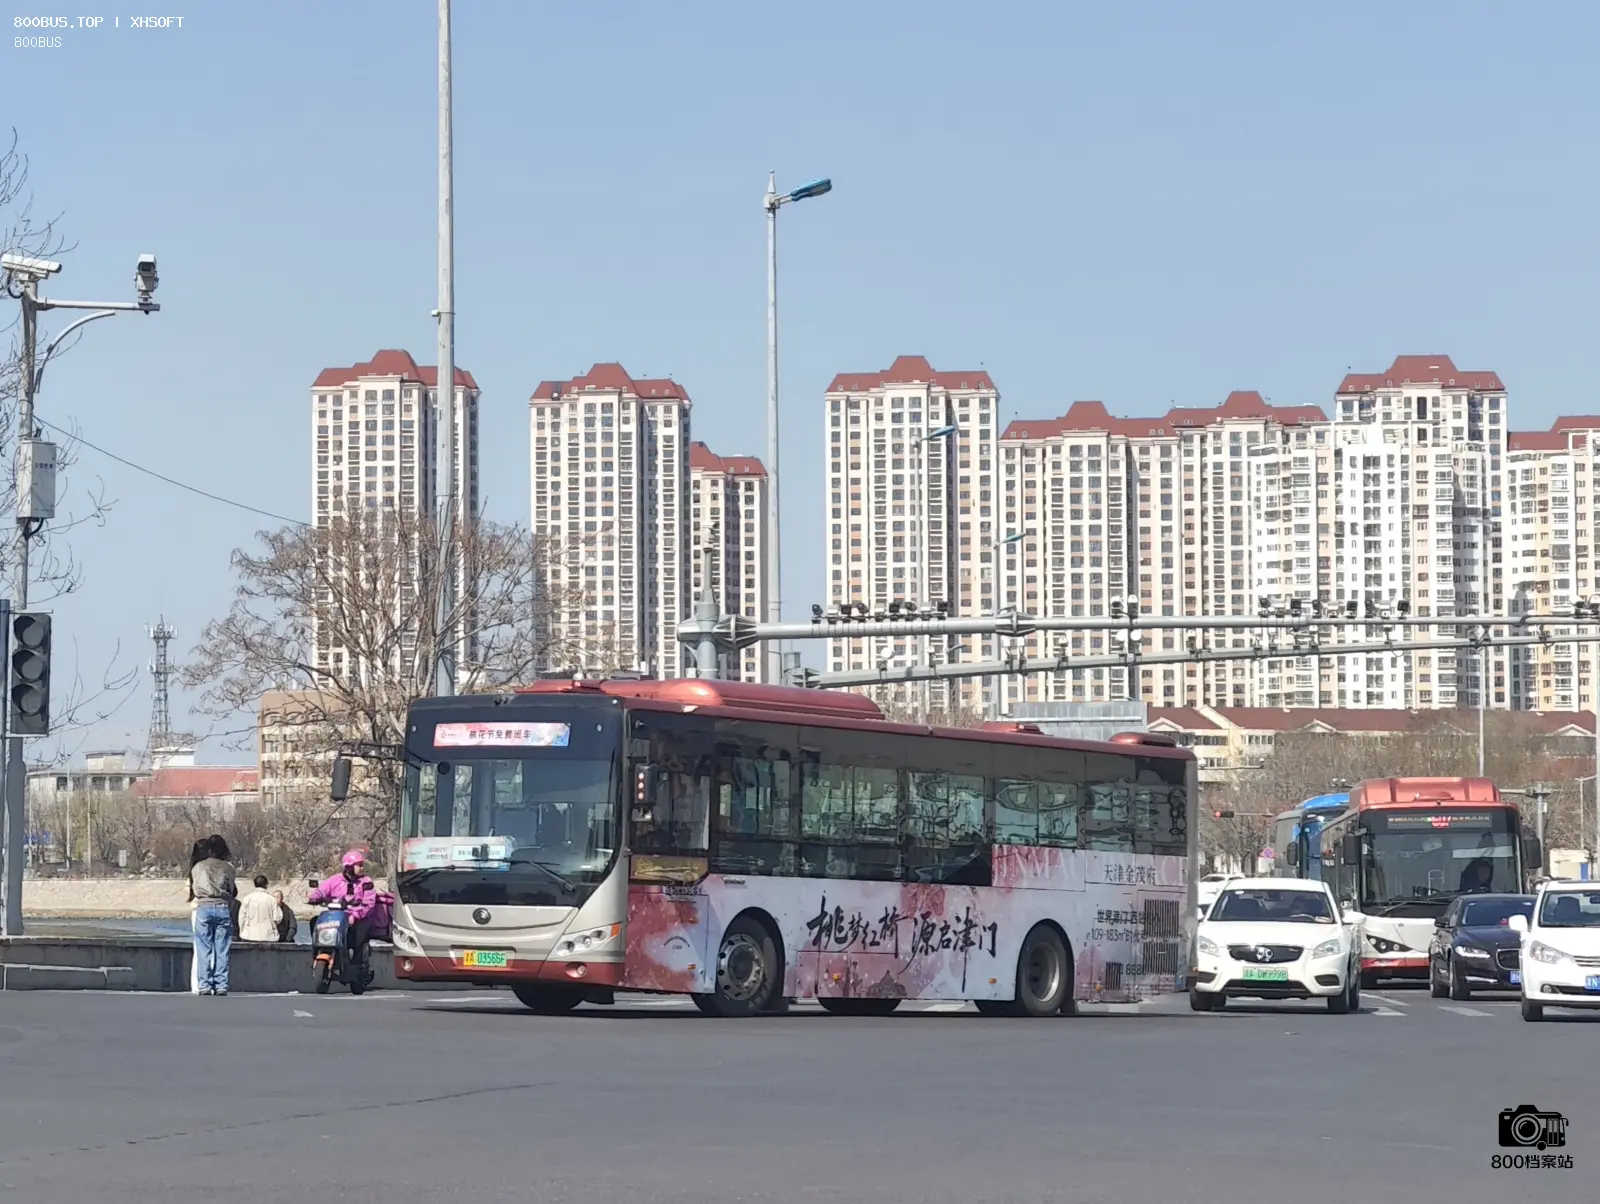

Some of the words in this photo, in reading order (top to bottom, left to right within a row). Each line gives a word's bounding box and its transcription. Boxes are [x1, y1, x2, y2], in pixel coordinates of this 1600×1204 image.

[1103, 863, 1157, 885] 天津金茂府
